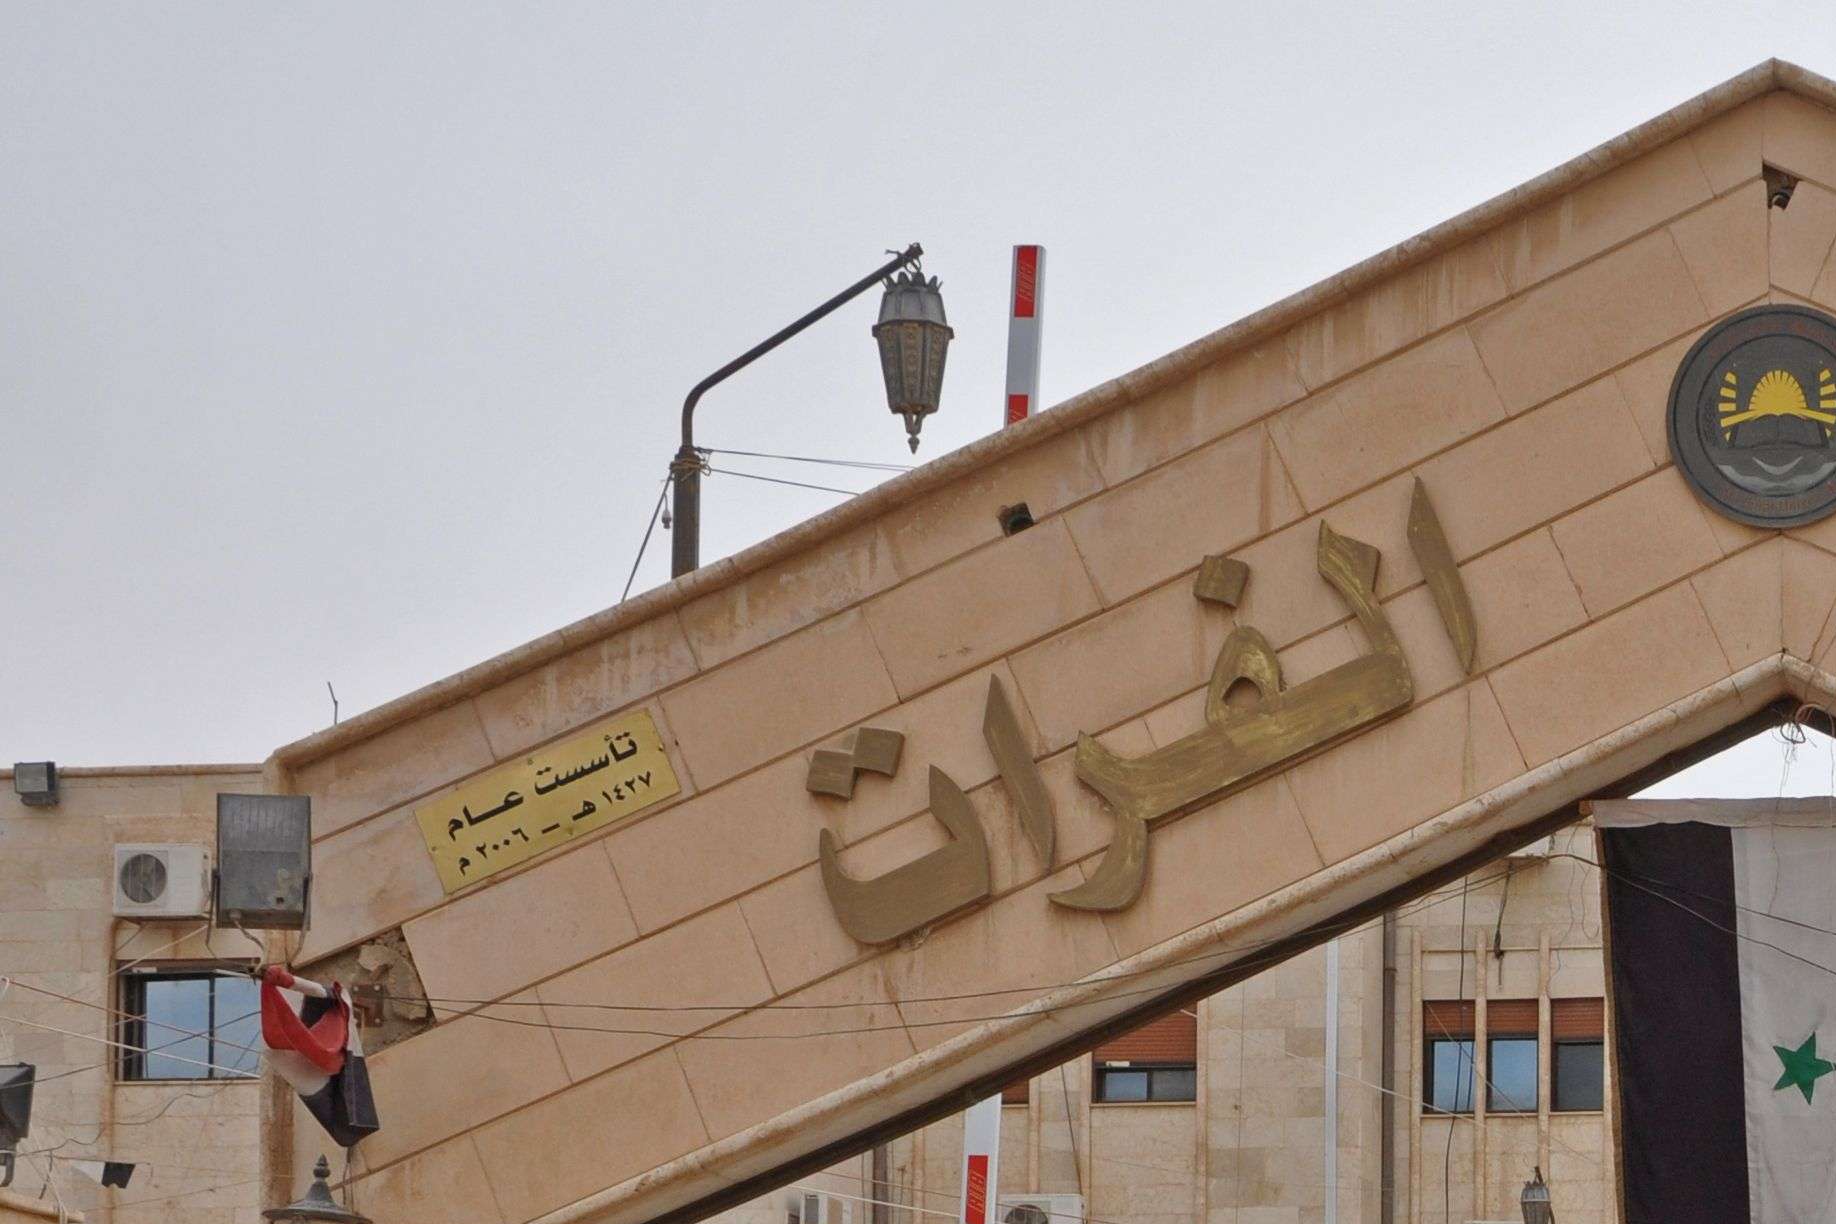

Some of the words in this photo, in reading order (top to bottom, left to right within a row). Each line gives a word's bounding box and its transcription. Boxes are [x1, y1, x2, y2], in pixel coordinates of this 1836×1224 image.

[807, 475, 1478, 944] الفرات
[534, 731, 638, 796] تأسست
[602, 770, 651, 804] ١٤٢٧
[475, 827, 529, 859] ٢٠٠٦
[458, 856, 471, 876] م
